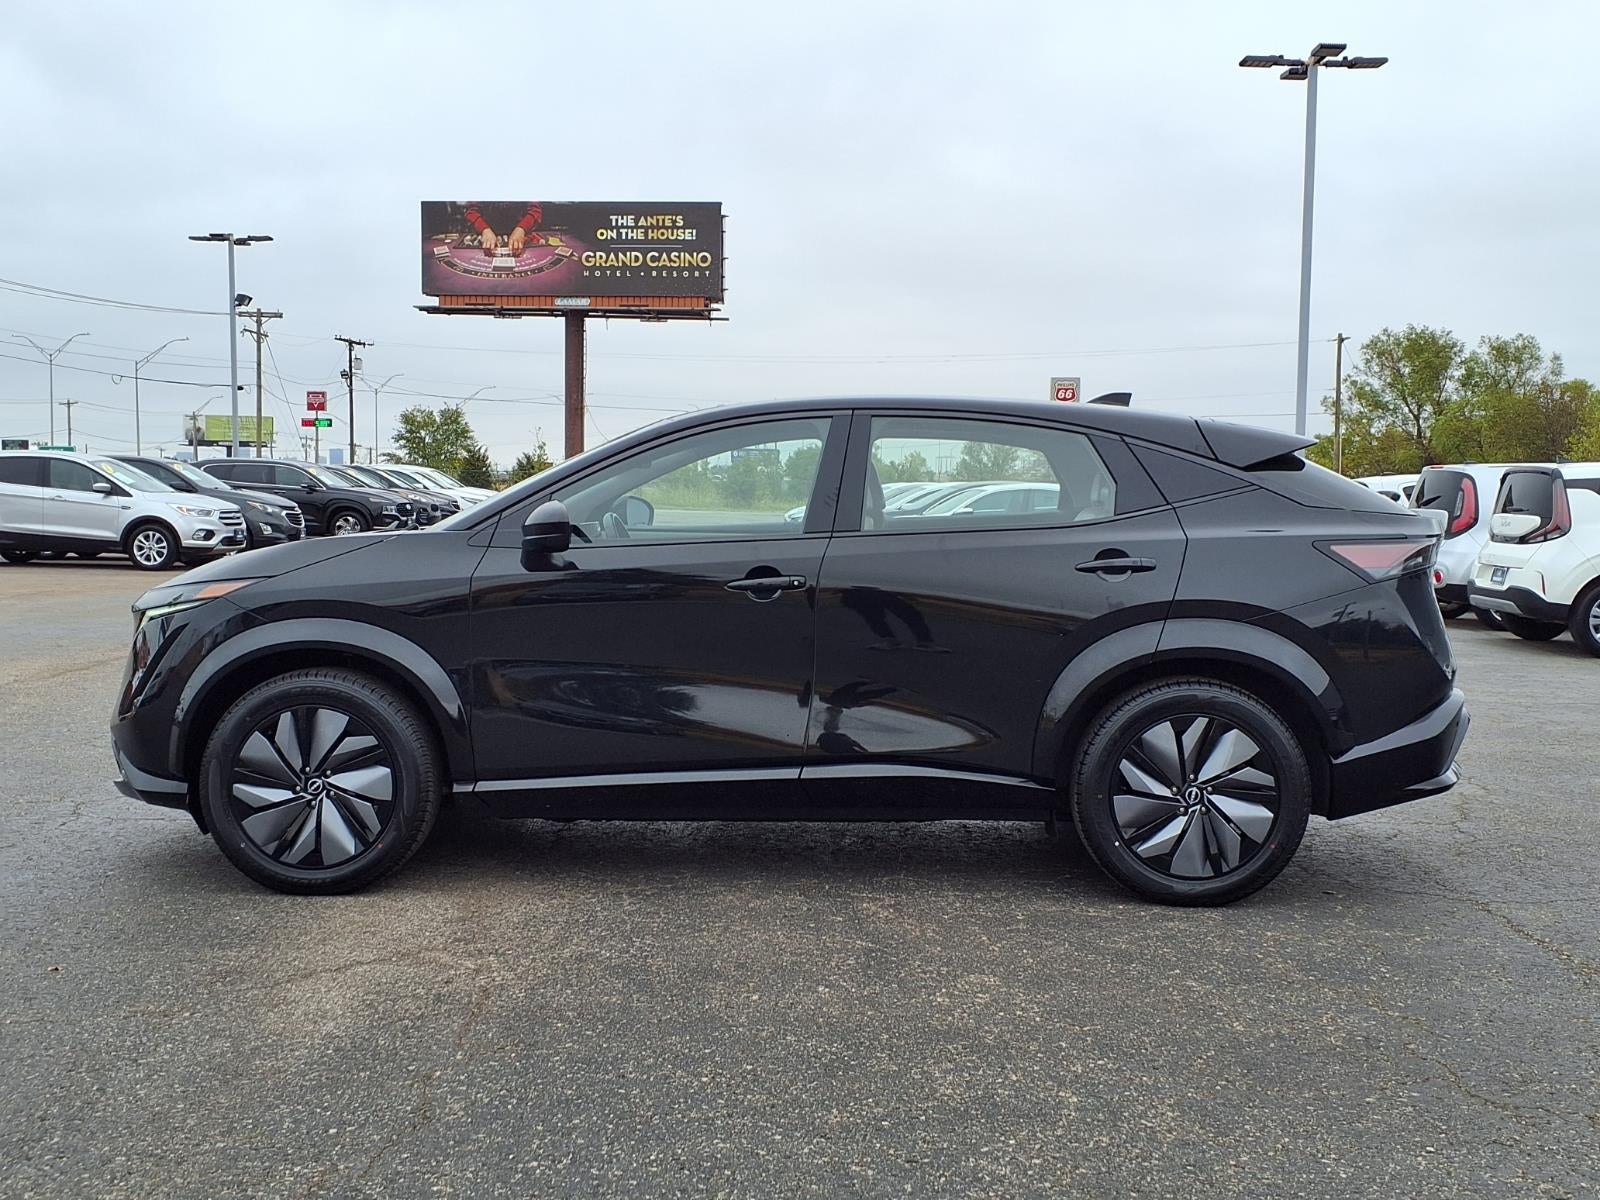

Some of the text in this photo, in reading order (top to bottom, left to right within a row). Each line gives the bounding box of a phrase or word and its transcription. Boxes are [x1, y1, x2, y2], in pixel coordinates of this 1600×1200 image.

[609, 215, 684, 227] THE ANTE'S
[596, 228, 697, 240] ON THE HOUSE!
[581, 251, 712, 267] GRAND CASINO
[652, 270, 710, 278] RESORT
[1057, 389, 1074, 399] 66
